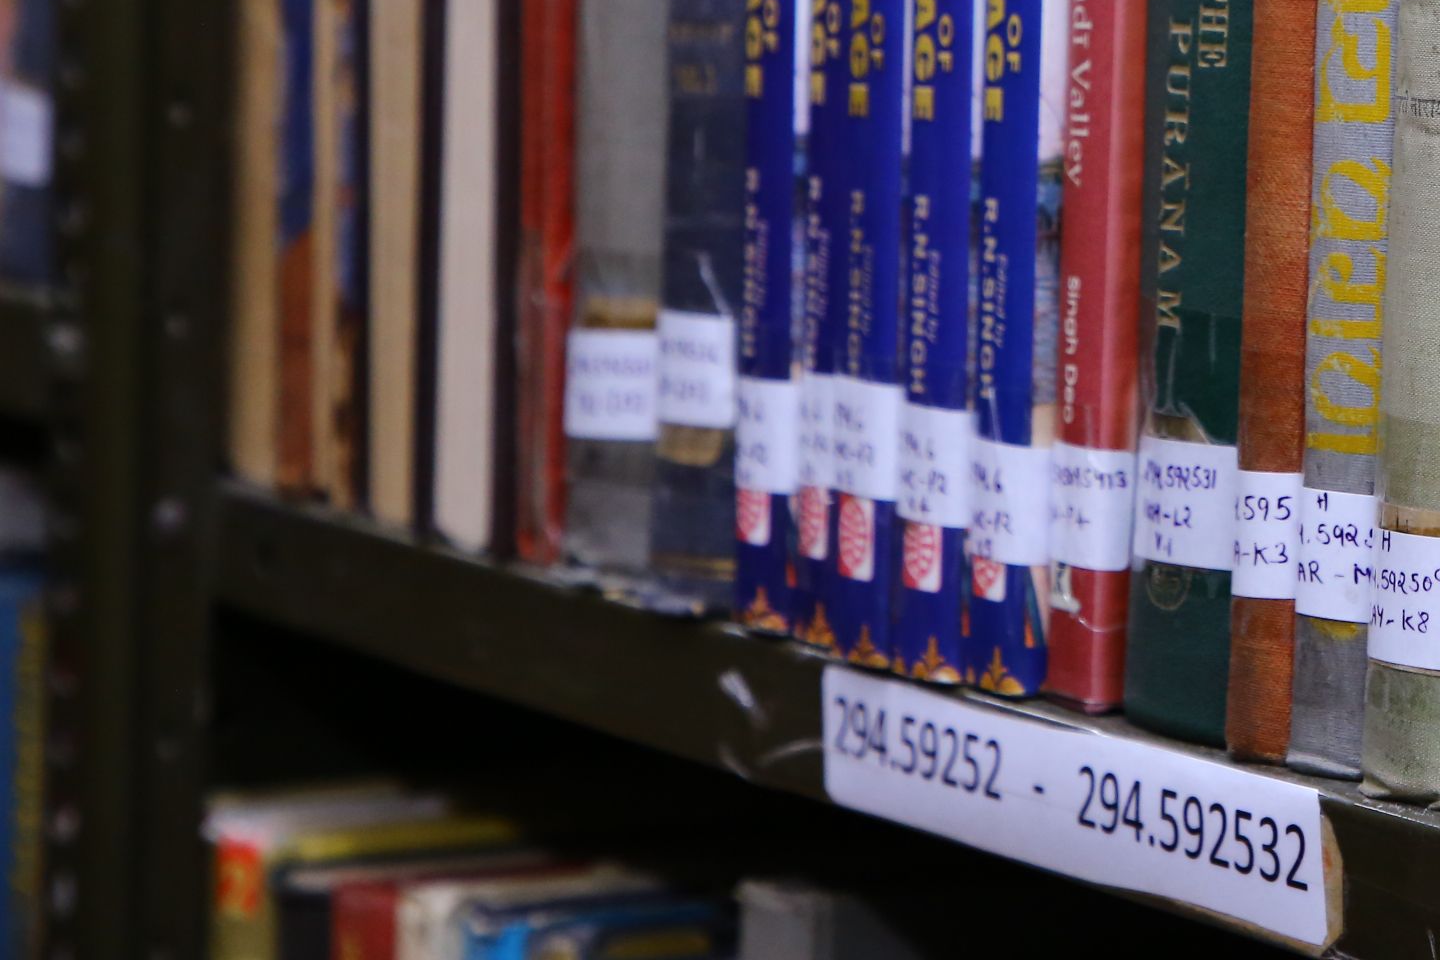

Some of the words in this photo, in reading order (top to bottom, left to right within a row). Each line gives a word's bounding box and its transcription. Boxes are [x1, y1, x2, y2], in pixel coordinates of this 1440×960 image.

[937, 14, 954, 71] OF
[1004, 14, 1022, 74] OF
[1066, 59, 1092, 189] Valley
[1064, 276, 1081, 358] Singh
[1062, 362, 1079, 424] Deo
[1316, 492, 1329, 512] H
[1381, 529, 1392, 553] H
[834, 697, 1003, 801] 294.59252
[1078, 765, 1310, 893] 294.592532
